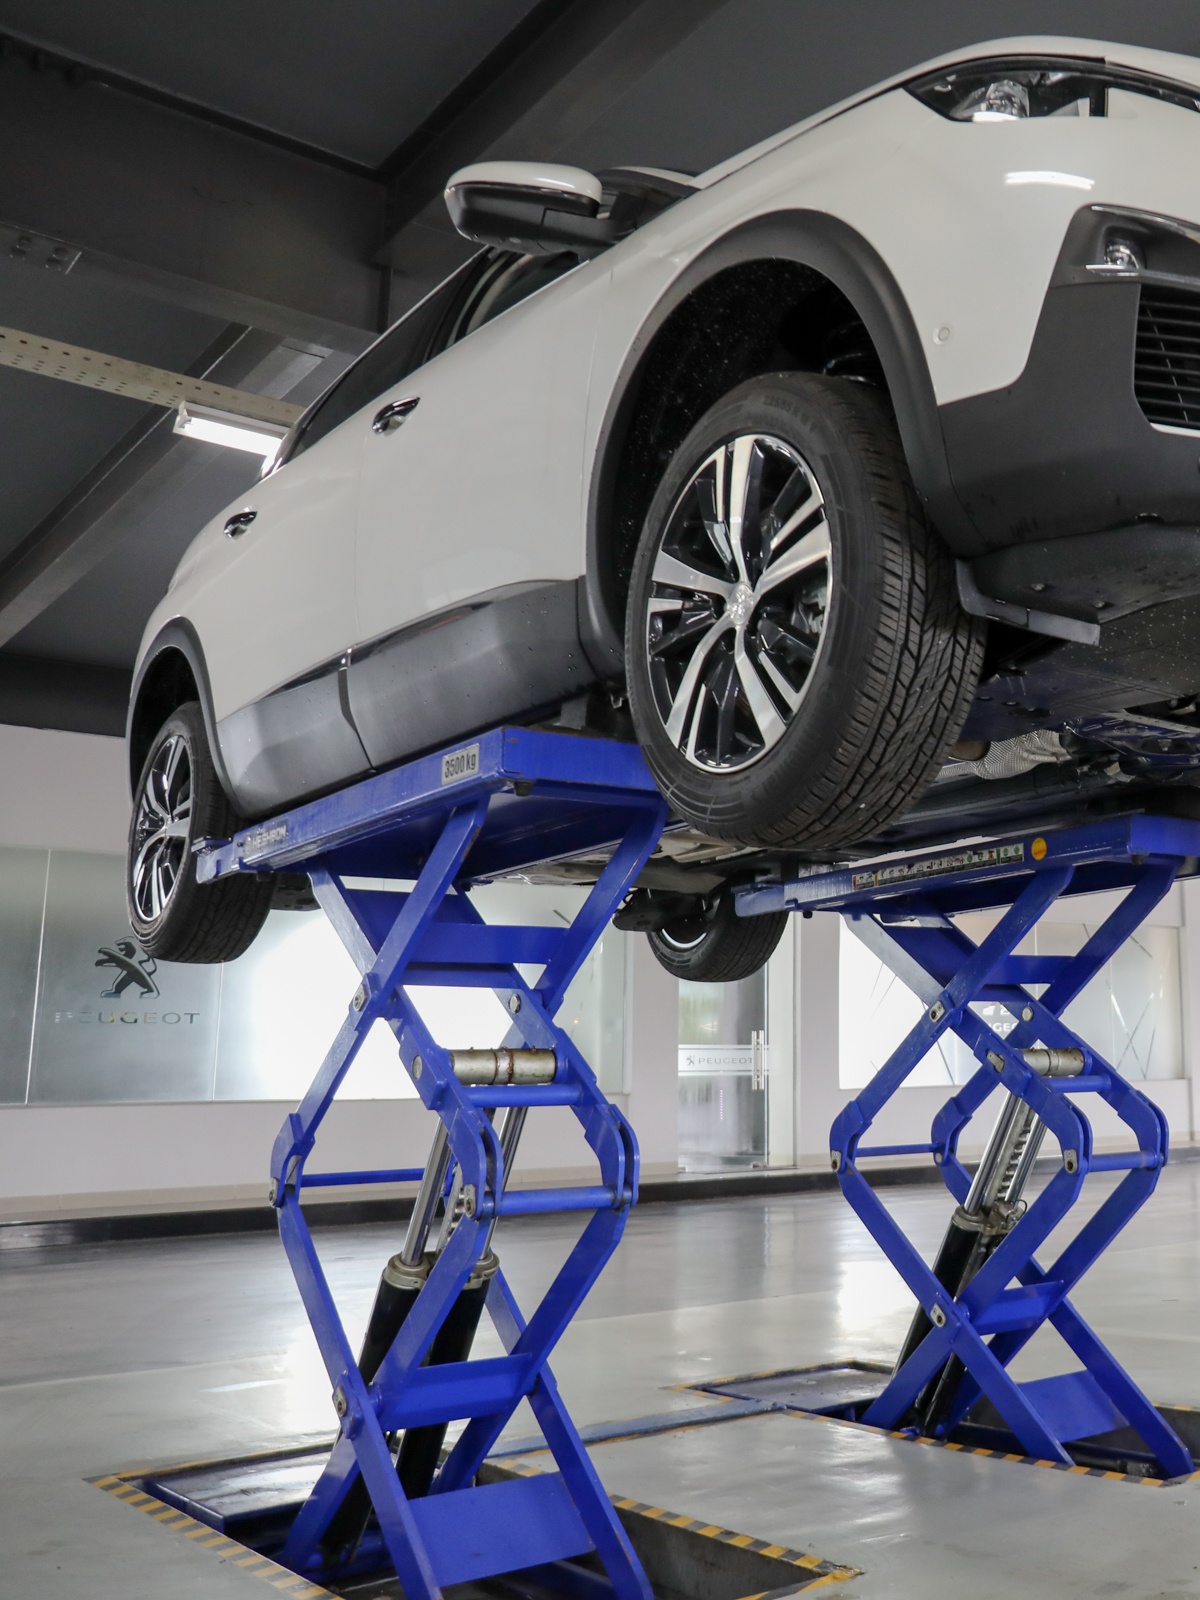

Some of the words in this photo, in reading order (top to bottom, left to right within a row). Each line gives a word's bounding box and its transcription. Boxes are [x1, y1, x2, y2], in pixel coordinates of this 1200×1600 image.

[445, 755, 465, 778] 3500
[466, 753, 476, 770] kg
[55, 1011, 200, 1024] PEUGEOT
